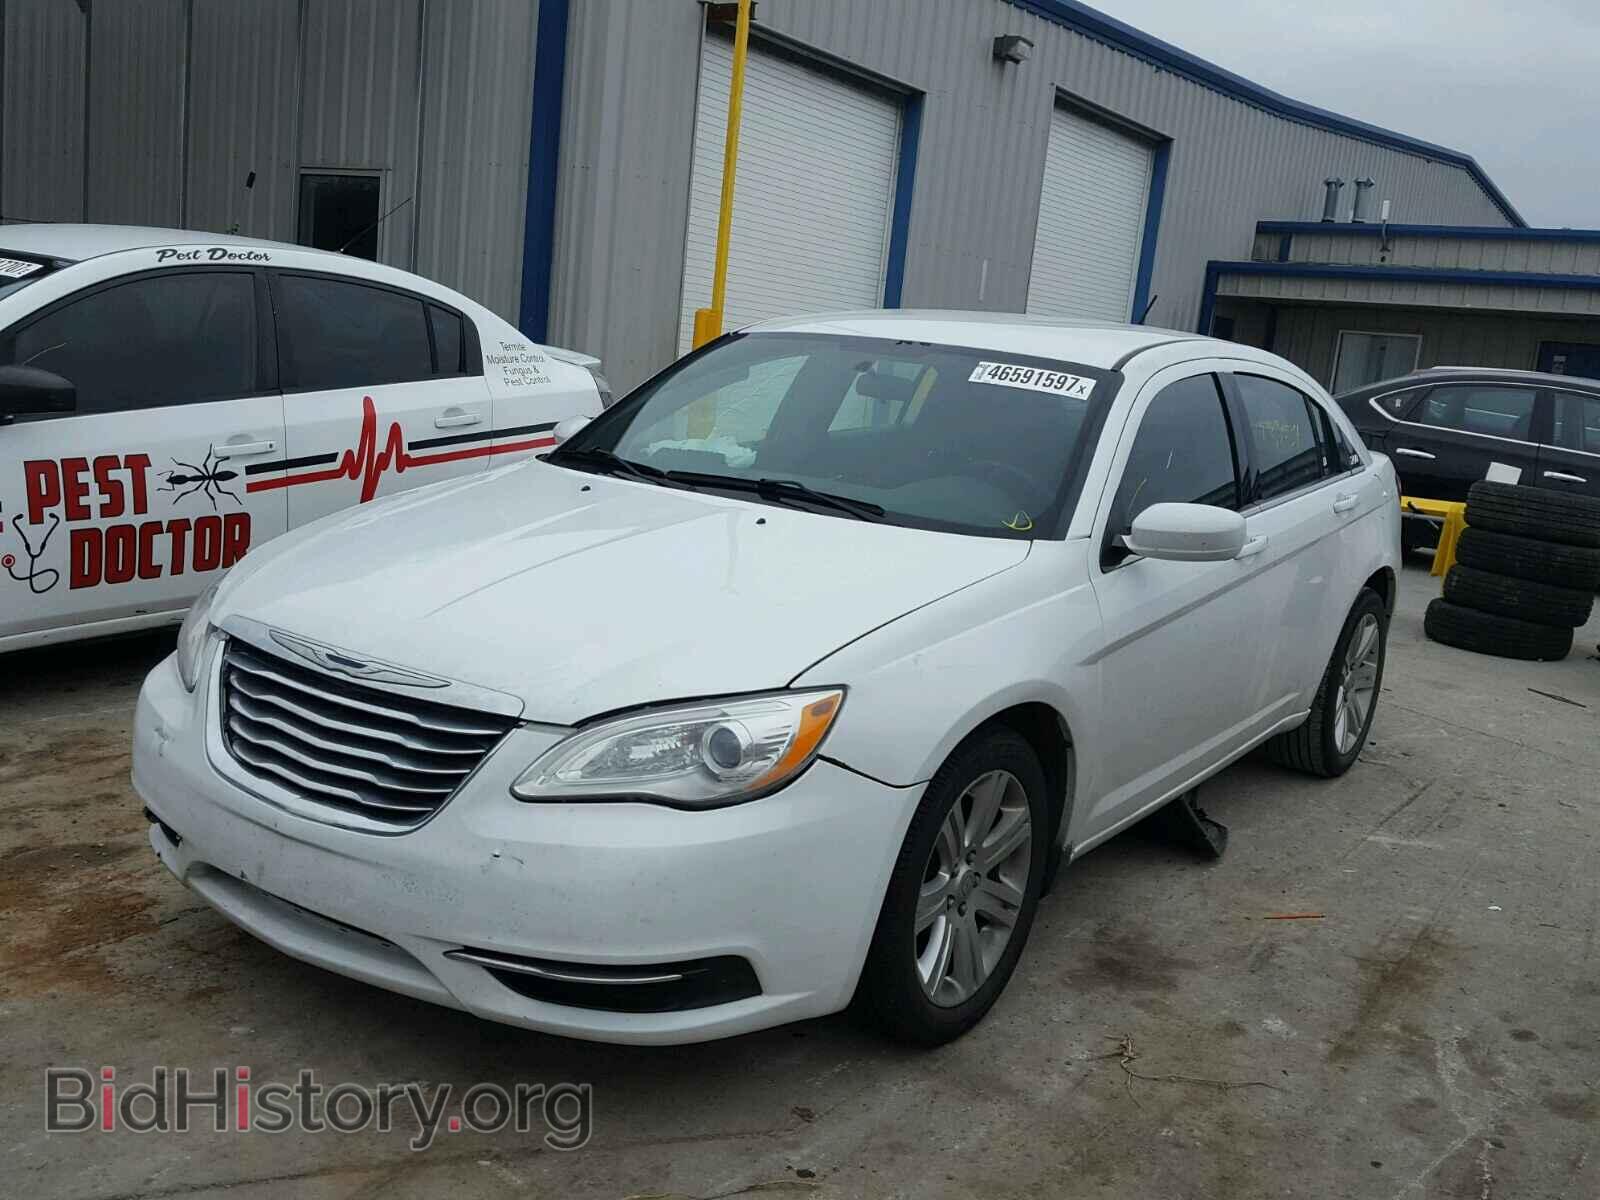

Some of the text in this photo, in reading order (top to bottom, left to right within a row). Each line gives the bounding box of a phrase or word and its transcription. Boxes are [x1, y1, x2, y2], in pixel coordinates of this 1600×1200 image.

[156, 247, 272, 262] Pest Doctor
[499, 341, 527, 352] Termite
[486, 354, 519, 365] Moisture
[503, 366, 532, 377] Fungus
[503, 377, 521, 386] Pest
[24, 453, 152, 525] PEST
[69, 512, 251, 590] DOCTOR
